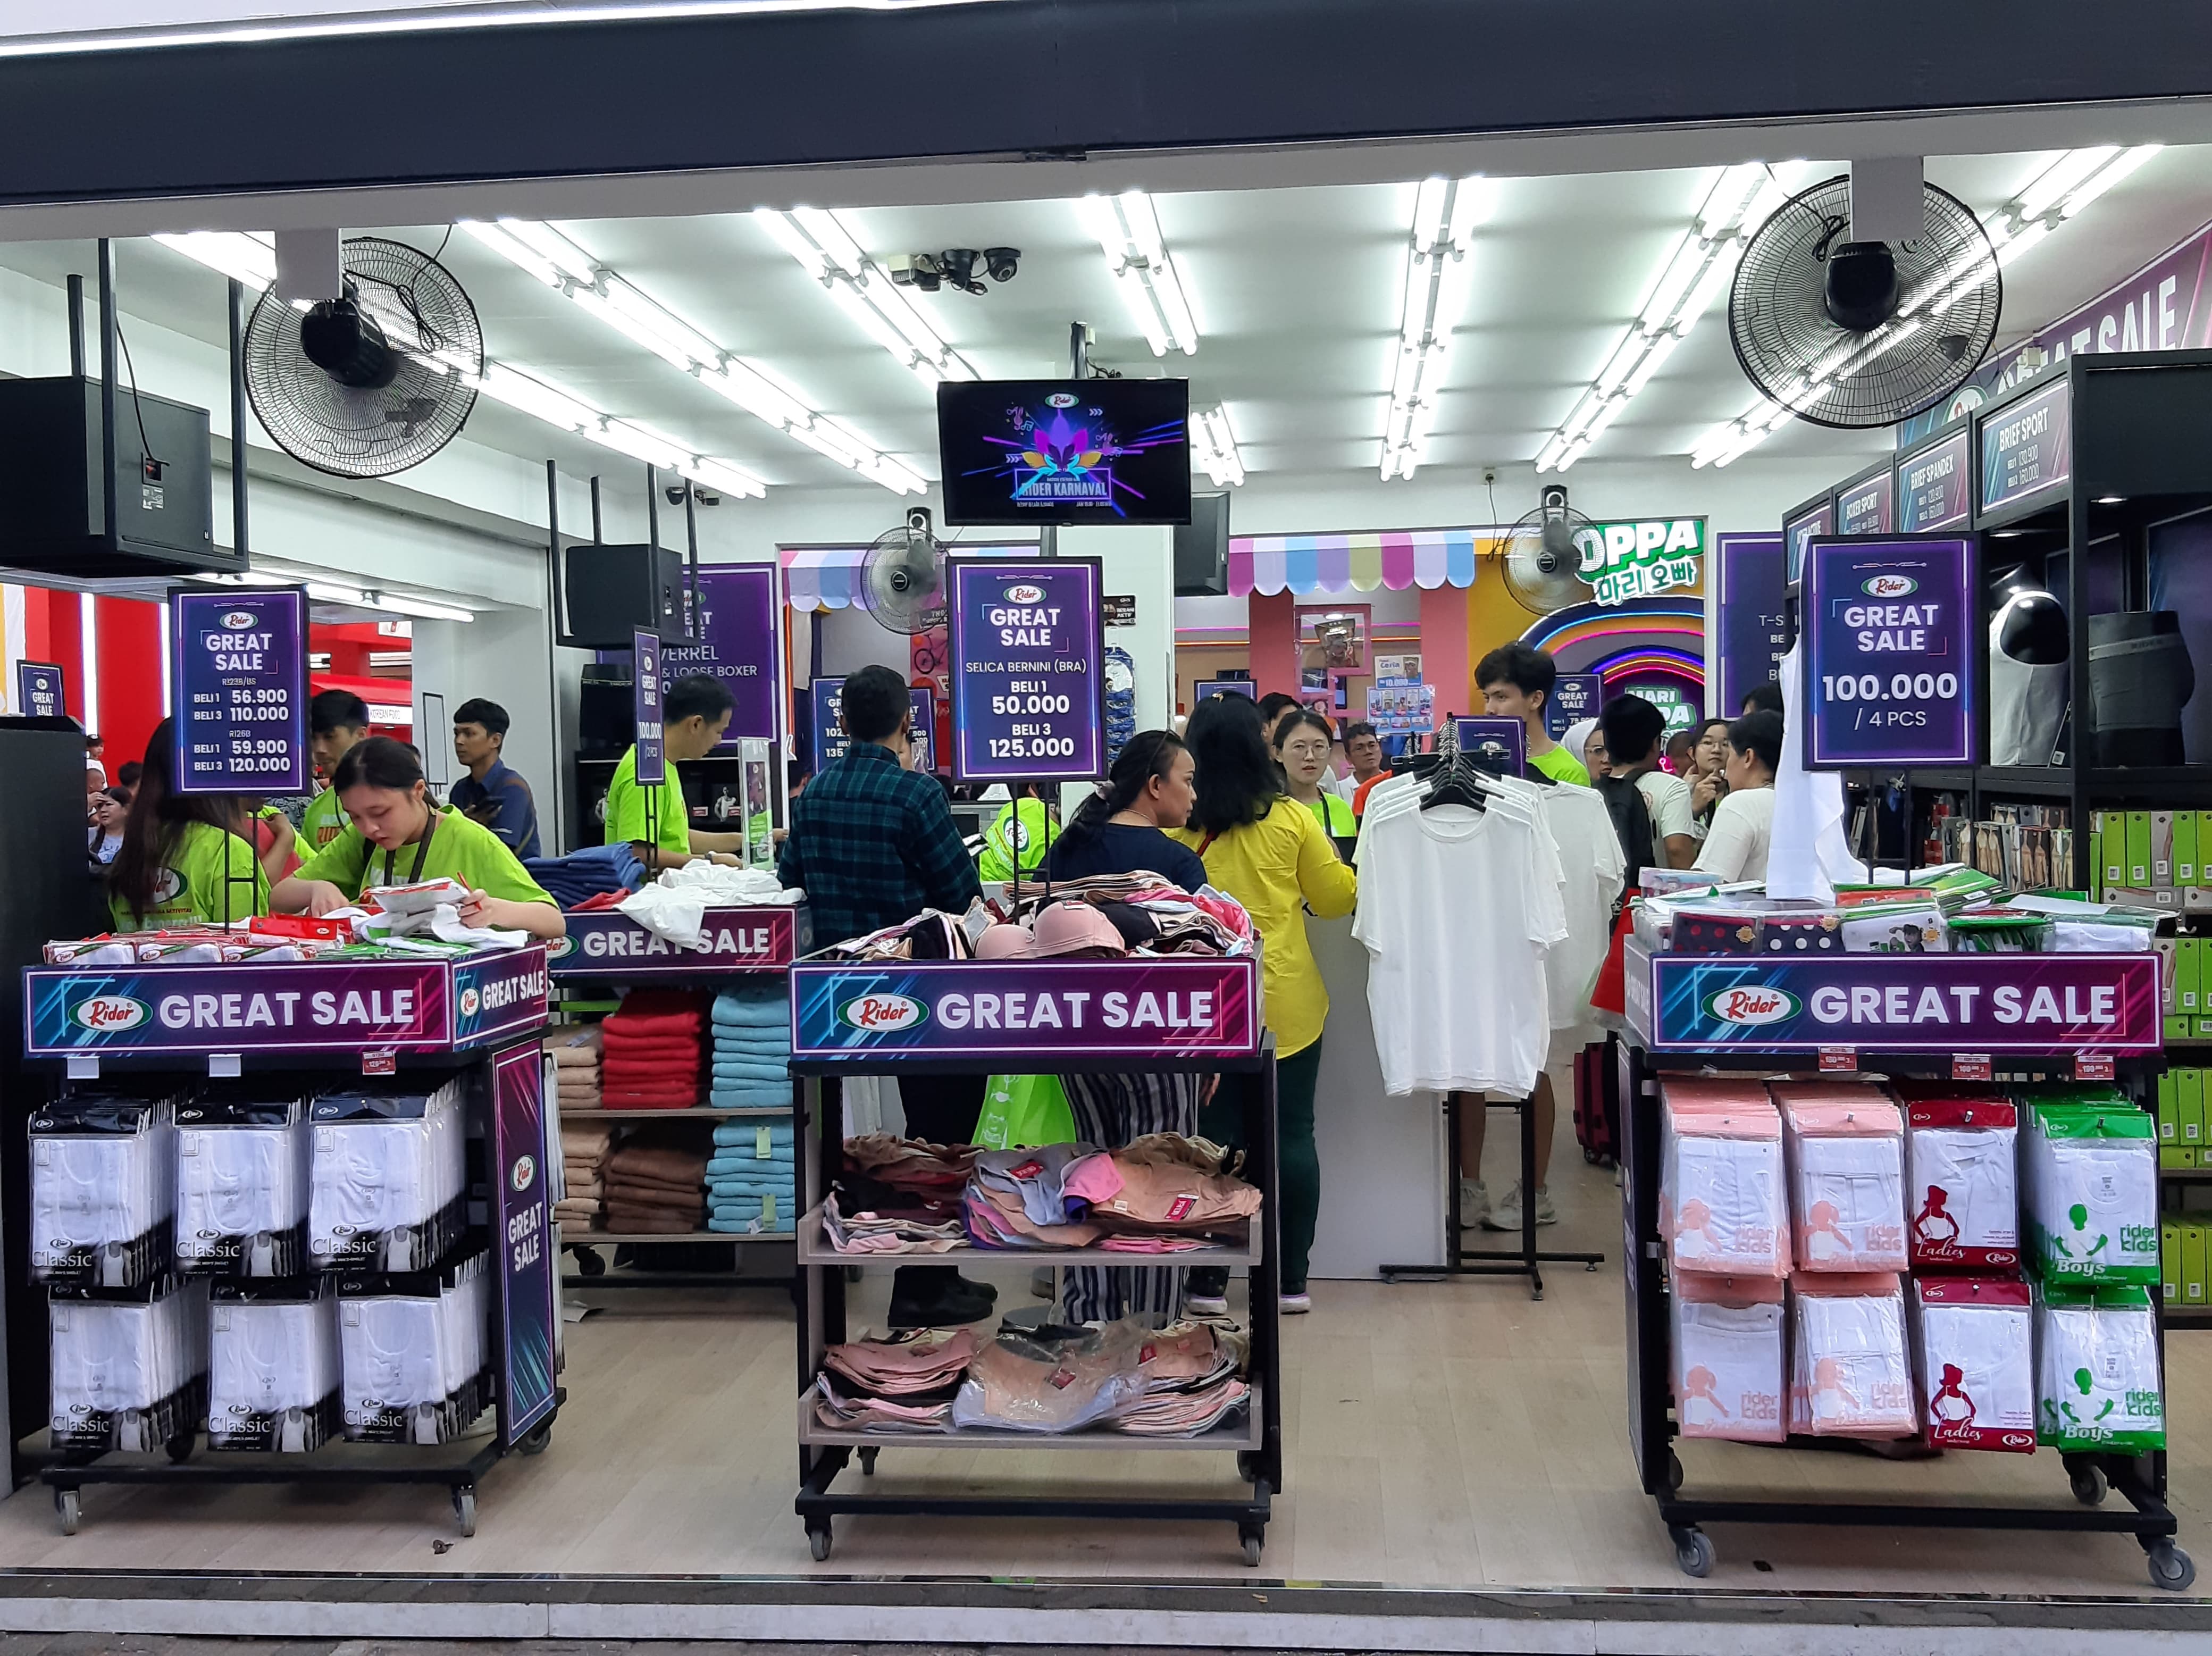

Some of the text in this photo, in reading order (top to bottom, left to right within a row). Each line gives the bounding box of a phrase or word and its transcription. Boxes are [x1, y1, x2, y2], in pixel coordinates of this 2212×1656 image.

[1999, 407, 2048, 451] BRIEF SPORT
[1911, 454, 1954, 490] BRIEF SPANDEX
[1054, 482, 1108, 496] KARNAVAL
[1572, 521, 1698, 572] OPPA
[1599, 561, 1695, 601] 마리 오빠
[1875, 579, 1906, 594] Rider
[1015, 588, 1037, 601] Rider
[229, 614, 250, 626] Rider
[990, 608, 1060, 626] GREAT
[1845, 605, 1939, 628] GREAT
[206, 633, 272, 651] GREAT
[1001, 629, 1051, 646] SALE
[1857, 630, 1925, 652] SALE
[215, 654, 263, 671] SALE
[966, 658, 1086, 674] SELICA BERNINI (BRA)
[661, 665, 757, 678] & LOOSE BOXER
[1011, 681, 1046, 692] BELI 1
[1822, 673, 1957, 701] 100.000
[32, 692, 54, 704] GREAT
[194, 689, 287, 704] BELI 1 56.900
[644, 692, 657, 706] SALE
[992, 695, 1070, 714] 50.000
[36, 705, 53, 716] SALE
[194, 707, 289, 721] BELI 3 110.000
[1869, 714, 1882, 726] 4
[1888, 711, 1926, 726] PCS
[639, 722, 661, 739] 100.000
[1012, 723, 1051, 736] BELI 3
[194, 740, 287, 754] BELI 1 59.900
[989, 738, 1074, 758] 125.000
[194, 757, 290, 772] BELI 3 120.000
[547, 939, 564, 951] der
[697, 929, 769, 954] SALE
[483, 977, 518, 1010] GREAT
[520, 971, 543, 999] SALE
[87, 989, 414, 1029] Rider GREAT SALE
[860, 991, 1213, 1030] Rider GREAT SALE
[1726, 985, 2116, 1024] Rider GREAT SALE
[508, 1201, 542, 1243] GREAT
[2120, 1224, 2156, 1237] rider
[176, 1241, 239, 1258] Classic
[311, 1236, 376, 1255] Classic
[515, 1233, 540, 1272] SALE
[1916, 1233, 1965, 1259] Ladies
[2121, 1237, 2157, 1251] kids
[32, 1250, 92, 1267] Classic
[2056, 1258, 2106, 1277] Boys
[1741, 1390, 1778, 1406] rider
[2125, 1387, 2159, 1402] rider
[1741, 1406, 1778, 1419] kids
[2126, 1401, 2162, 1416] kids
[52, 1416, 109, 1432] Classic
[208, 1416, 271, 1433] Classic
[344, 1409, 403, 1427] Classic
[1934, 1414, 1981, 1441] Ladies
[2064, 1424, 2114, 1442] Boys
